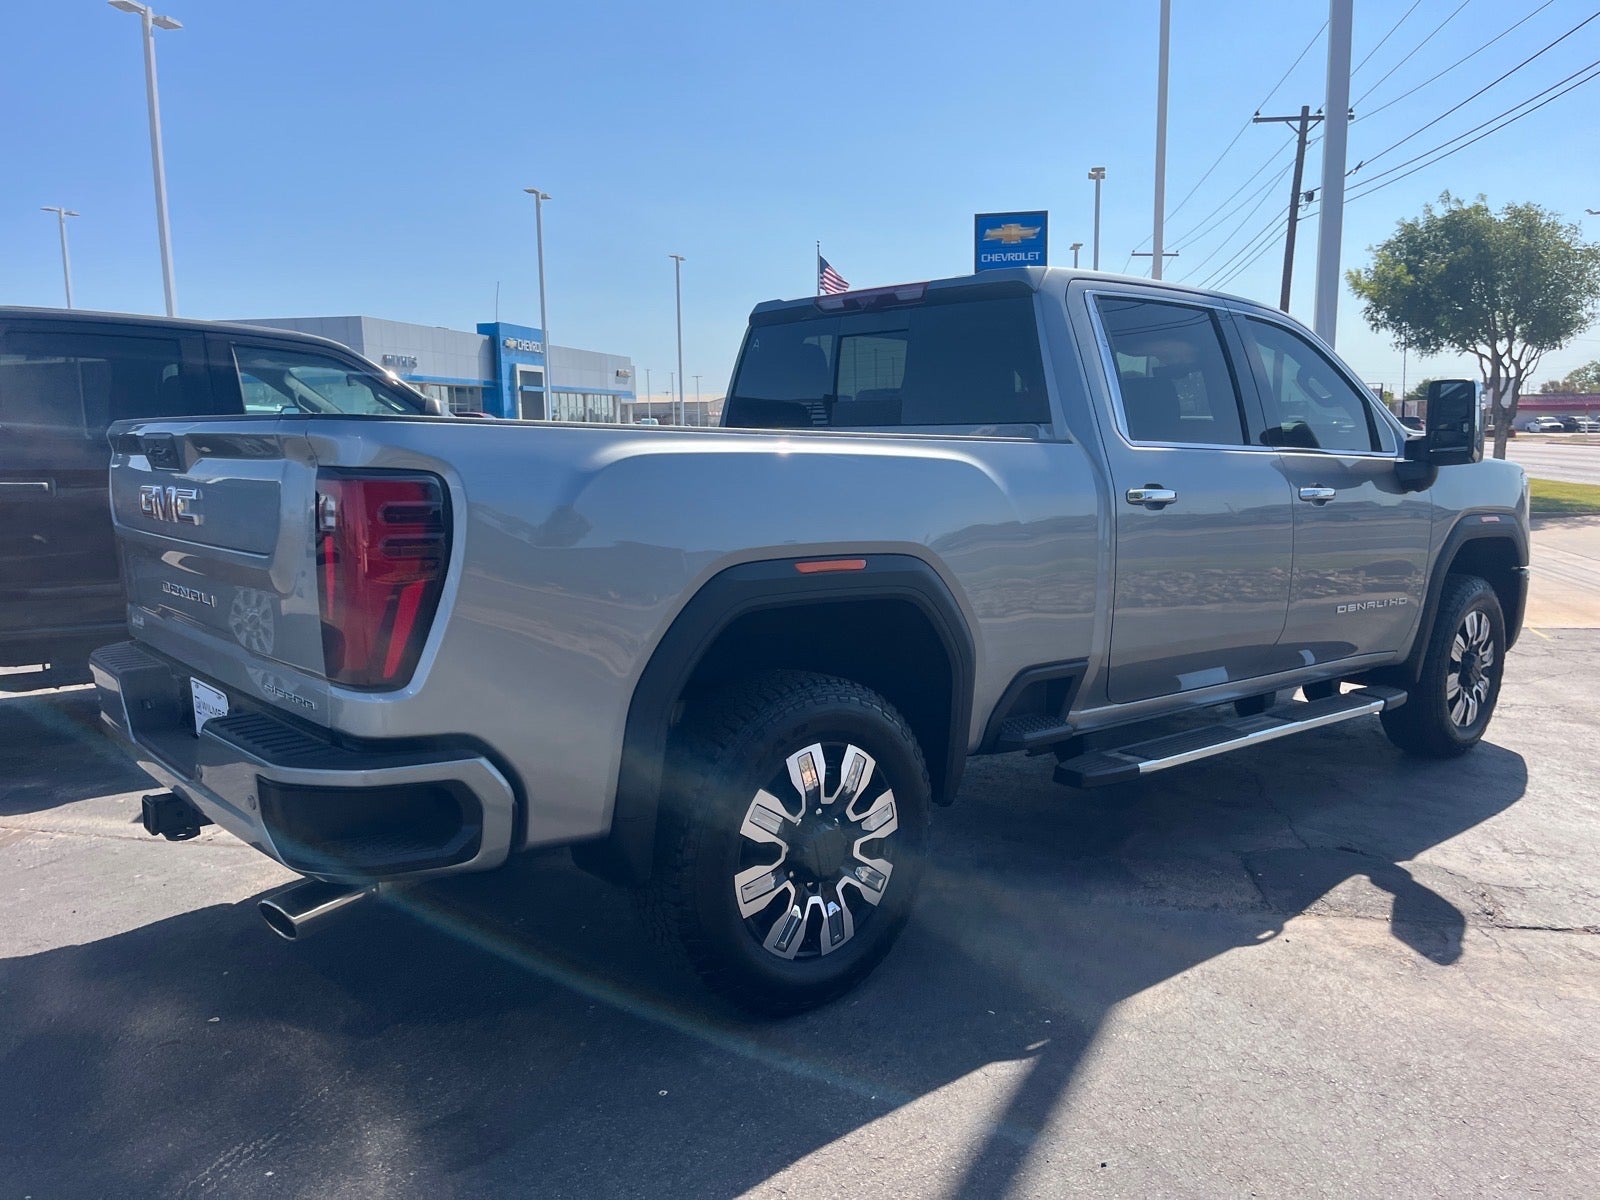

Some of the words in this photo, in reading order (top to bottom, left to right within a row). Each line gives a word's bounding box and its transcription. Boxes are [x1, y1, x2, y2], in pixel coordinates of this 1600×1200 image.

[981, 252, 1041, 263] CHEVROLET
[517, 339, 545, 354] CHEVROL
[139, 485, 204, 526] GMC
[161, 580, 217, 608] DENALI
[1336, 600, 1387, 614] DENALI
[1389, 597, 1408, 607] HD
[263, 682, 316, 710] SIERRA
